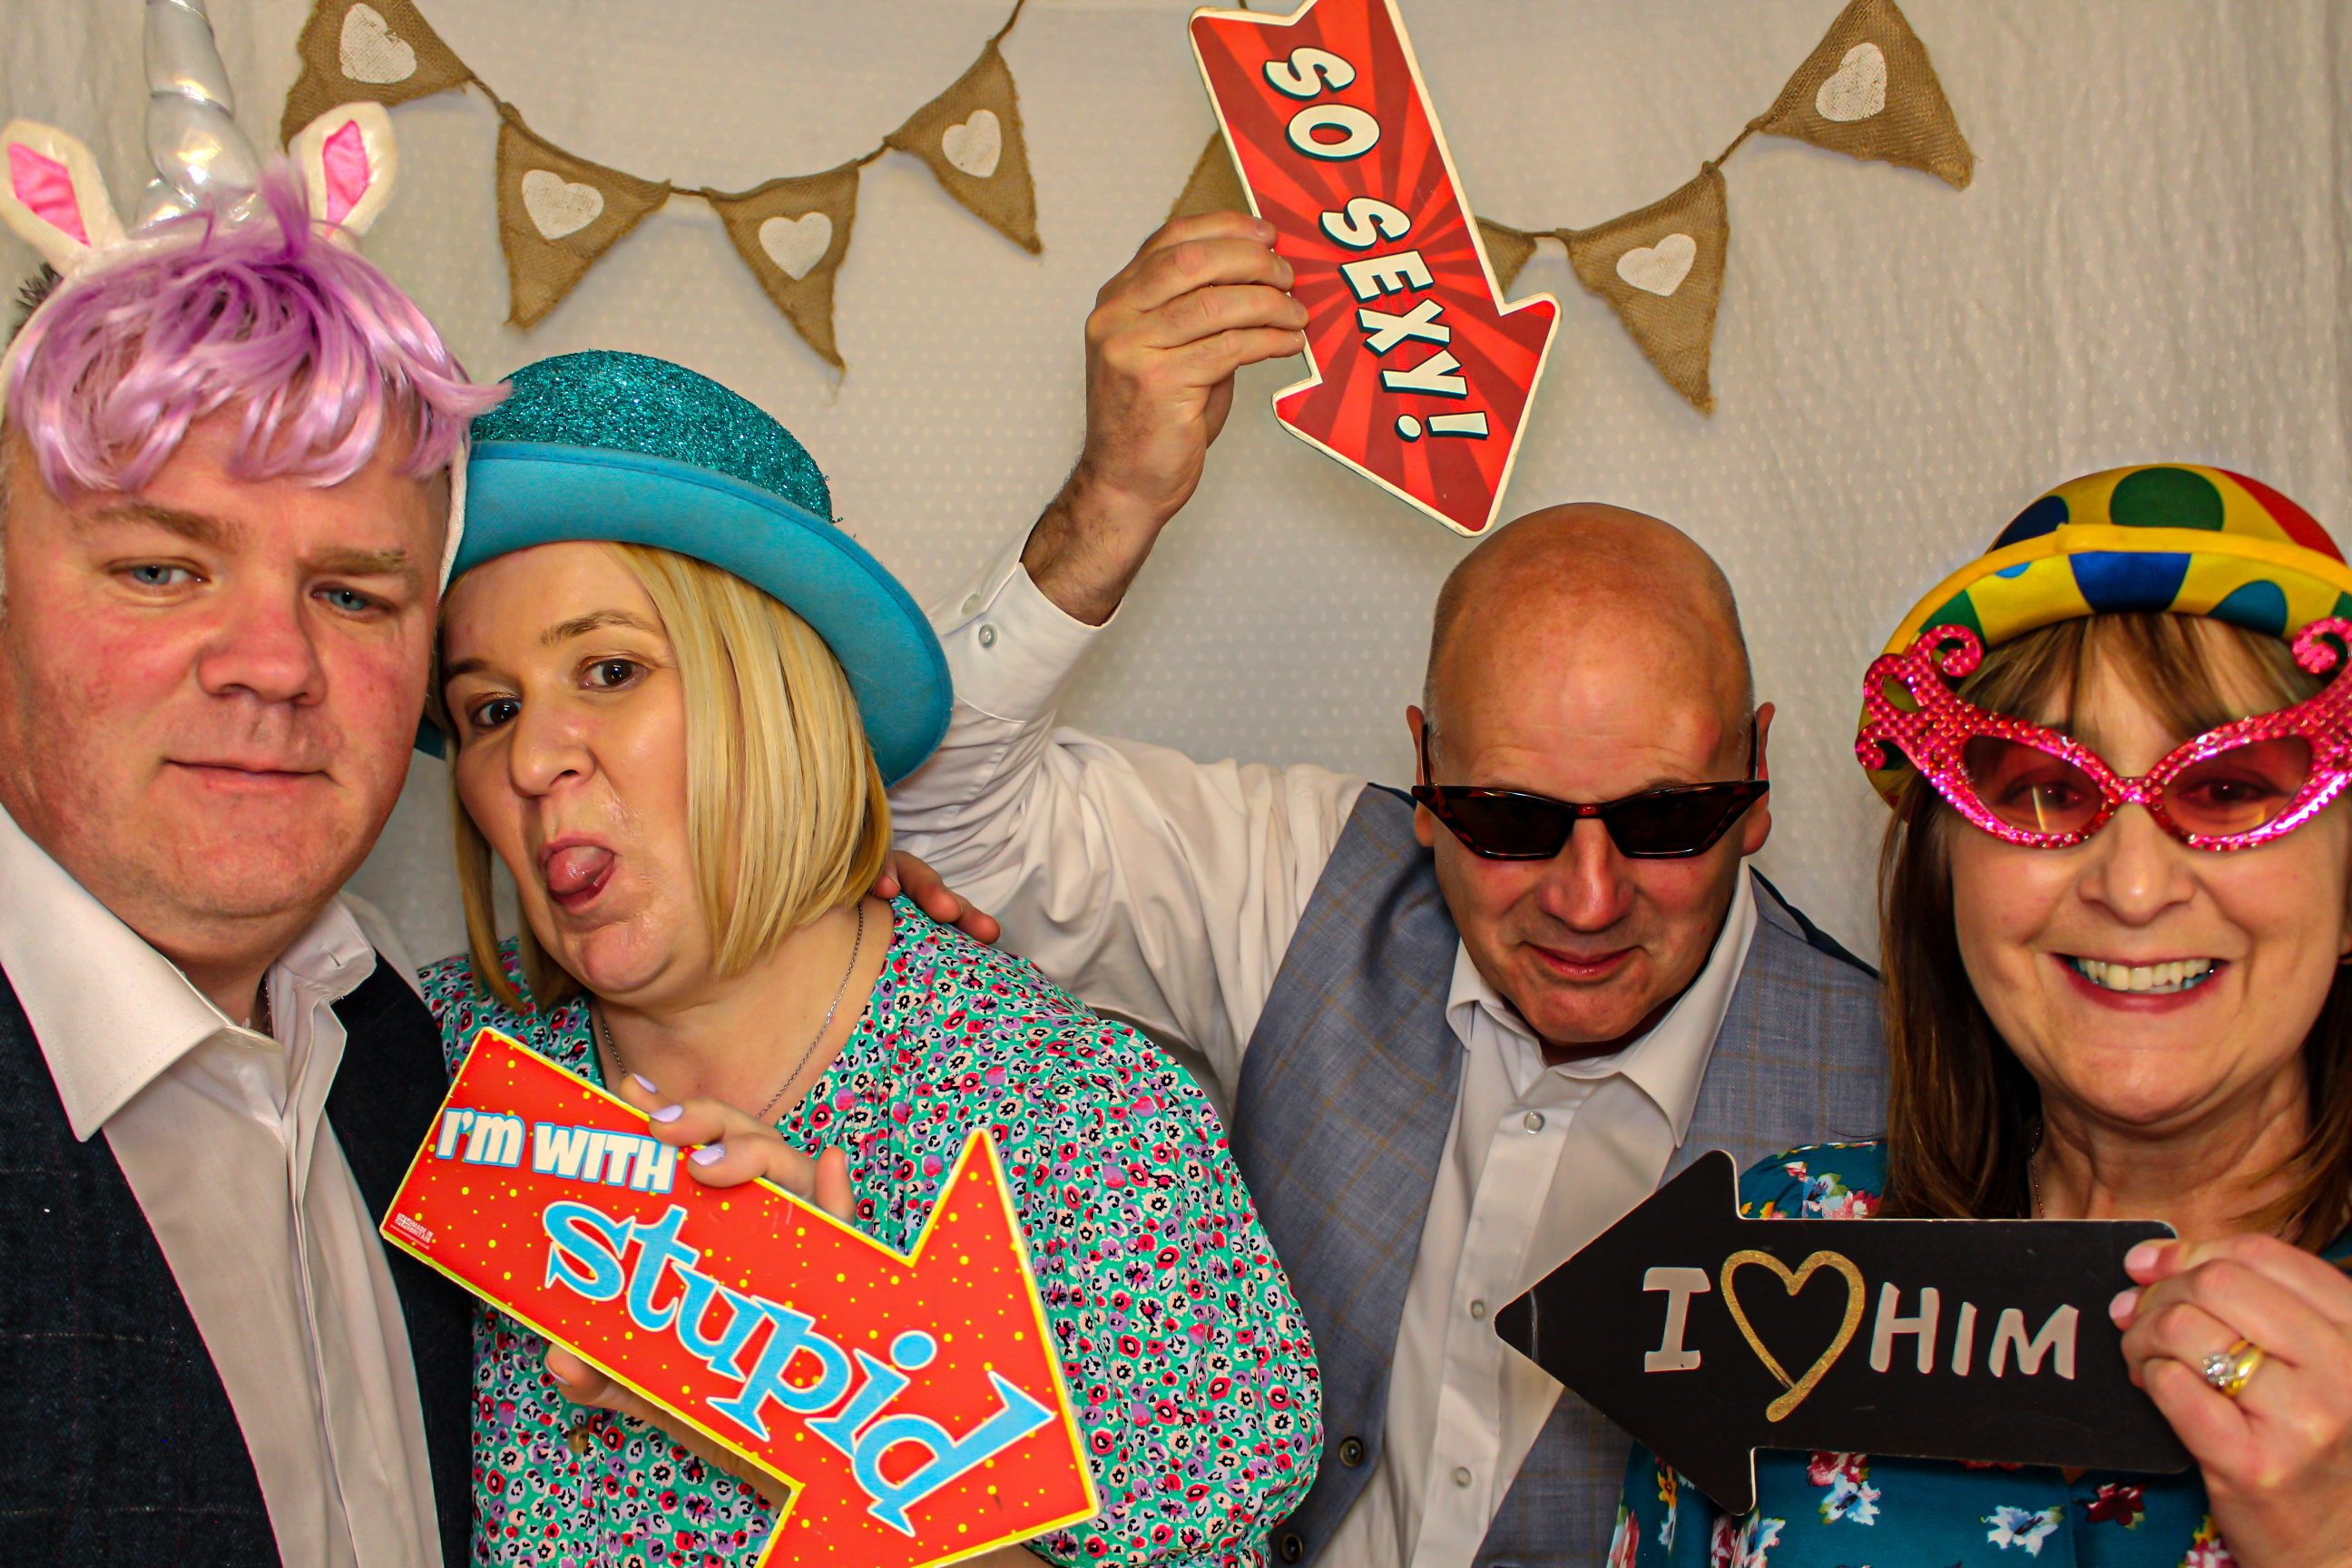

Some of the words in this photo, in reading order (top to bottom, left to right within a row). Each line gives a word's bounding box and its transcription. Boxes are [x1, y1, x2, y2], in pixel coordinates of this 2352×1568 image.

[1262, 46, 1381, 162] SO
[1319, 196, 1490, 443] SEXY!
[532, 1122, 679, 1194] WITH
[1642, 1267, 1711, 1373] I
[1869, 1281, 2080, 1381] HIM
